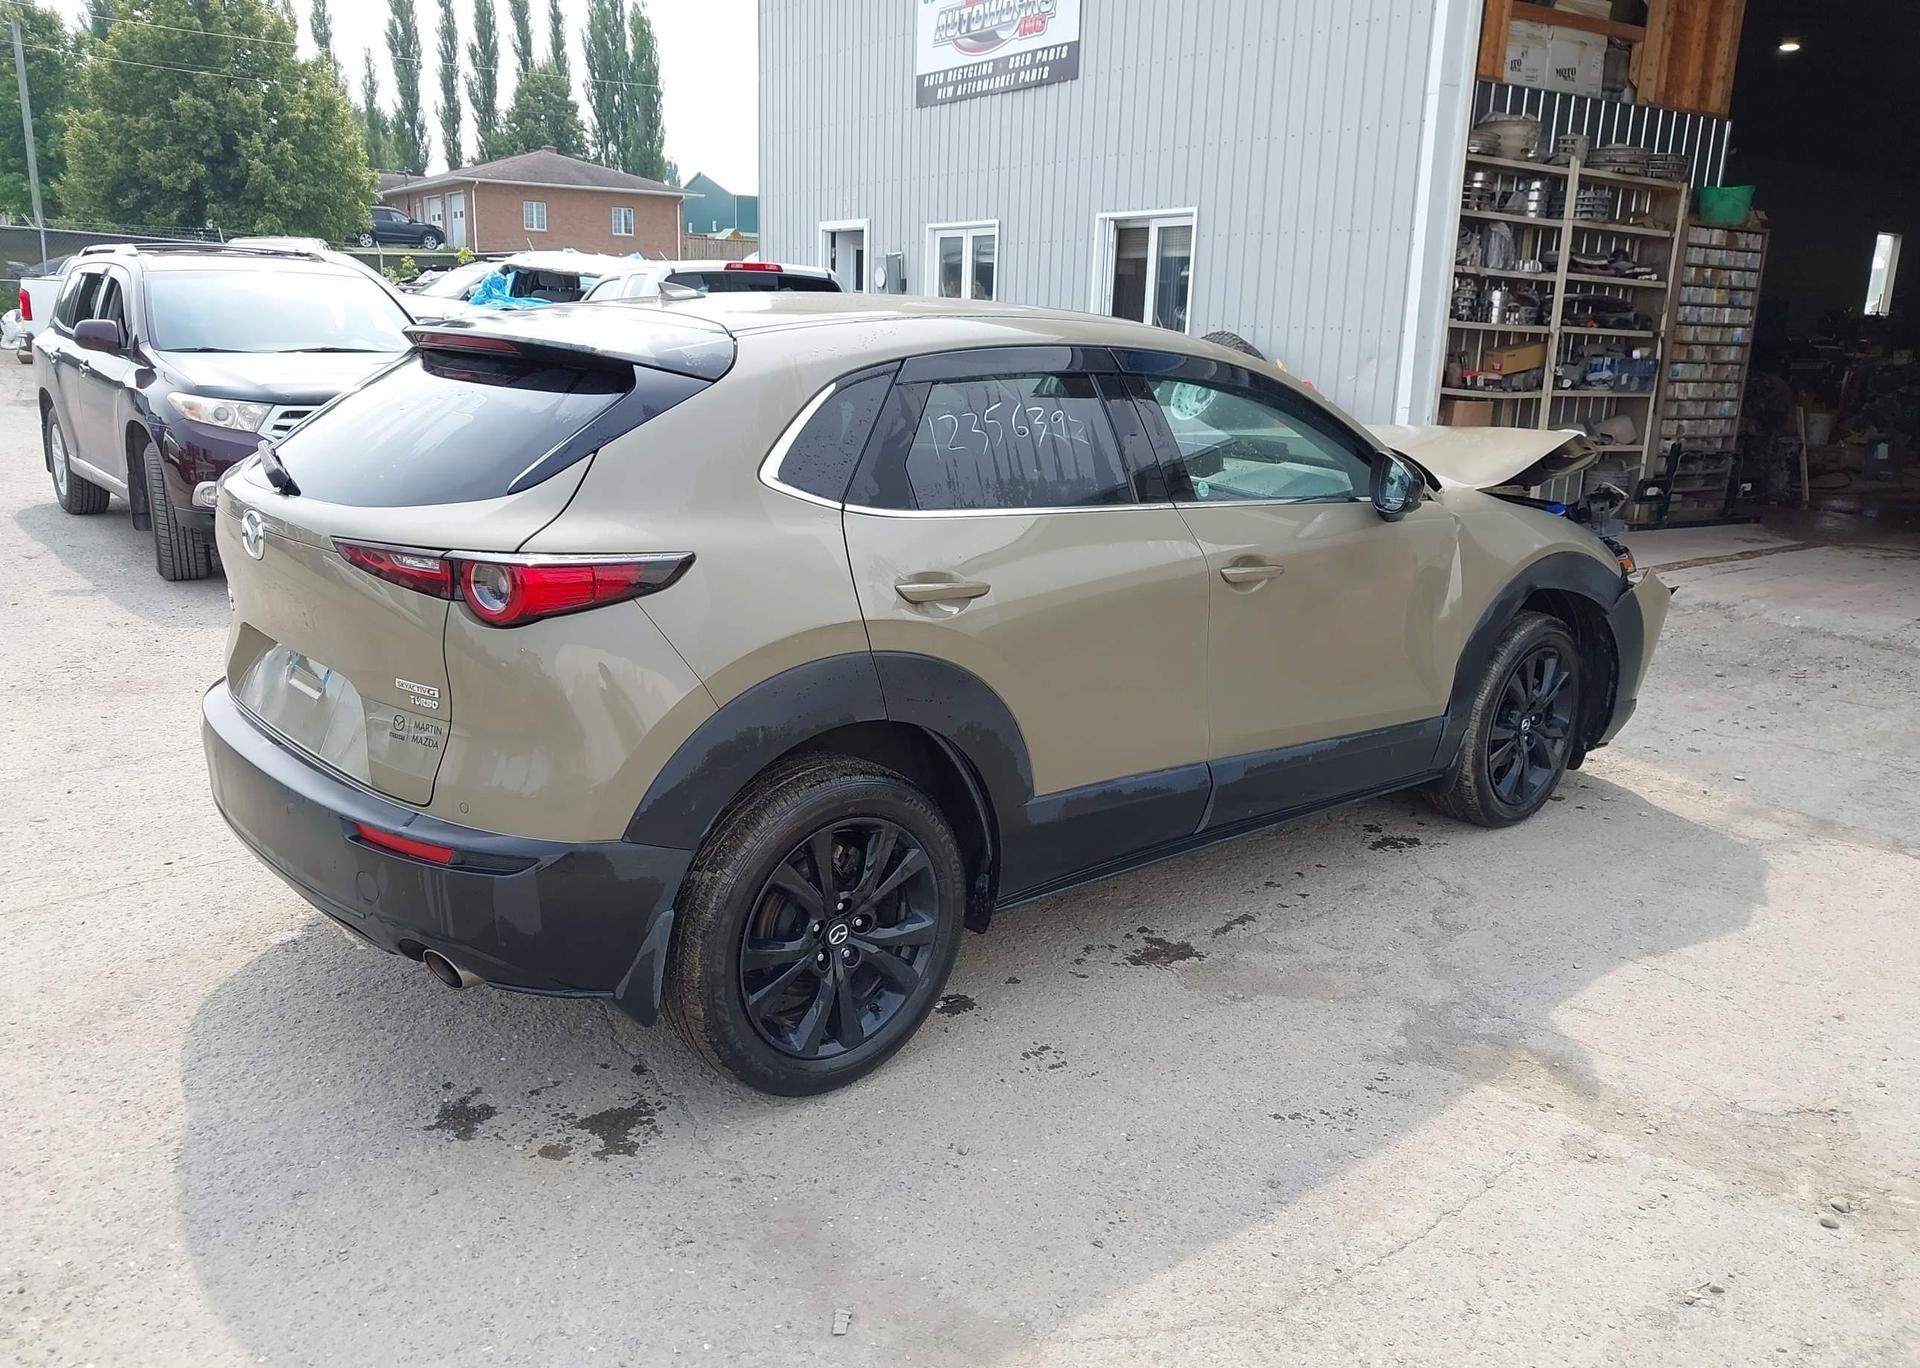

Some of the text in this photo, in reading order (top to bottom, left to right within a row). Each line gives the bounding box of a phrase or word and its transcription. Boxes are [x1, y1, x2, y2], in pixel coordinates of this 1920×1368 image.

[924, 45, 1068, 87] AUTO RECYCLING USED PARTS
[937, 66, 1050, 100] NEW AFTERMARKET PARTS
[409, 695, 439, 709] TURBO
[413, 720, 443, 736] MARTIN
[411, 734, 439, 750] MAZDA
